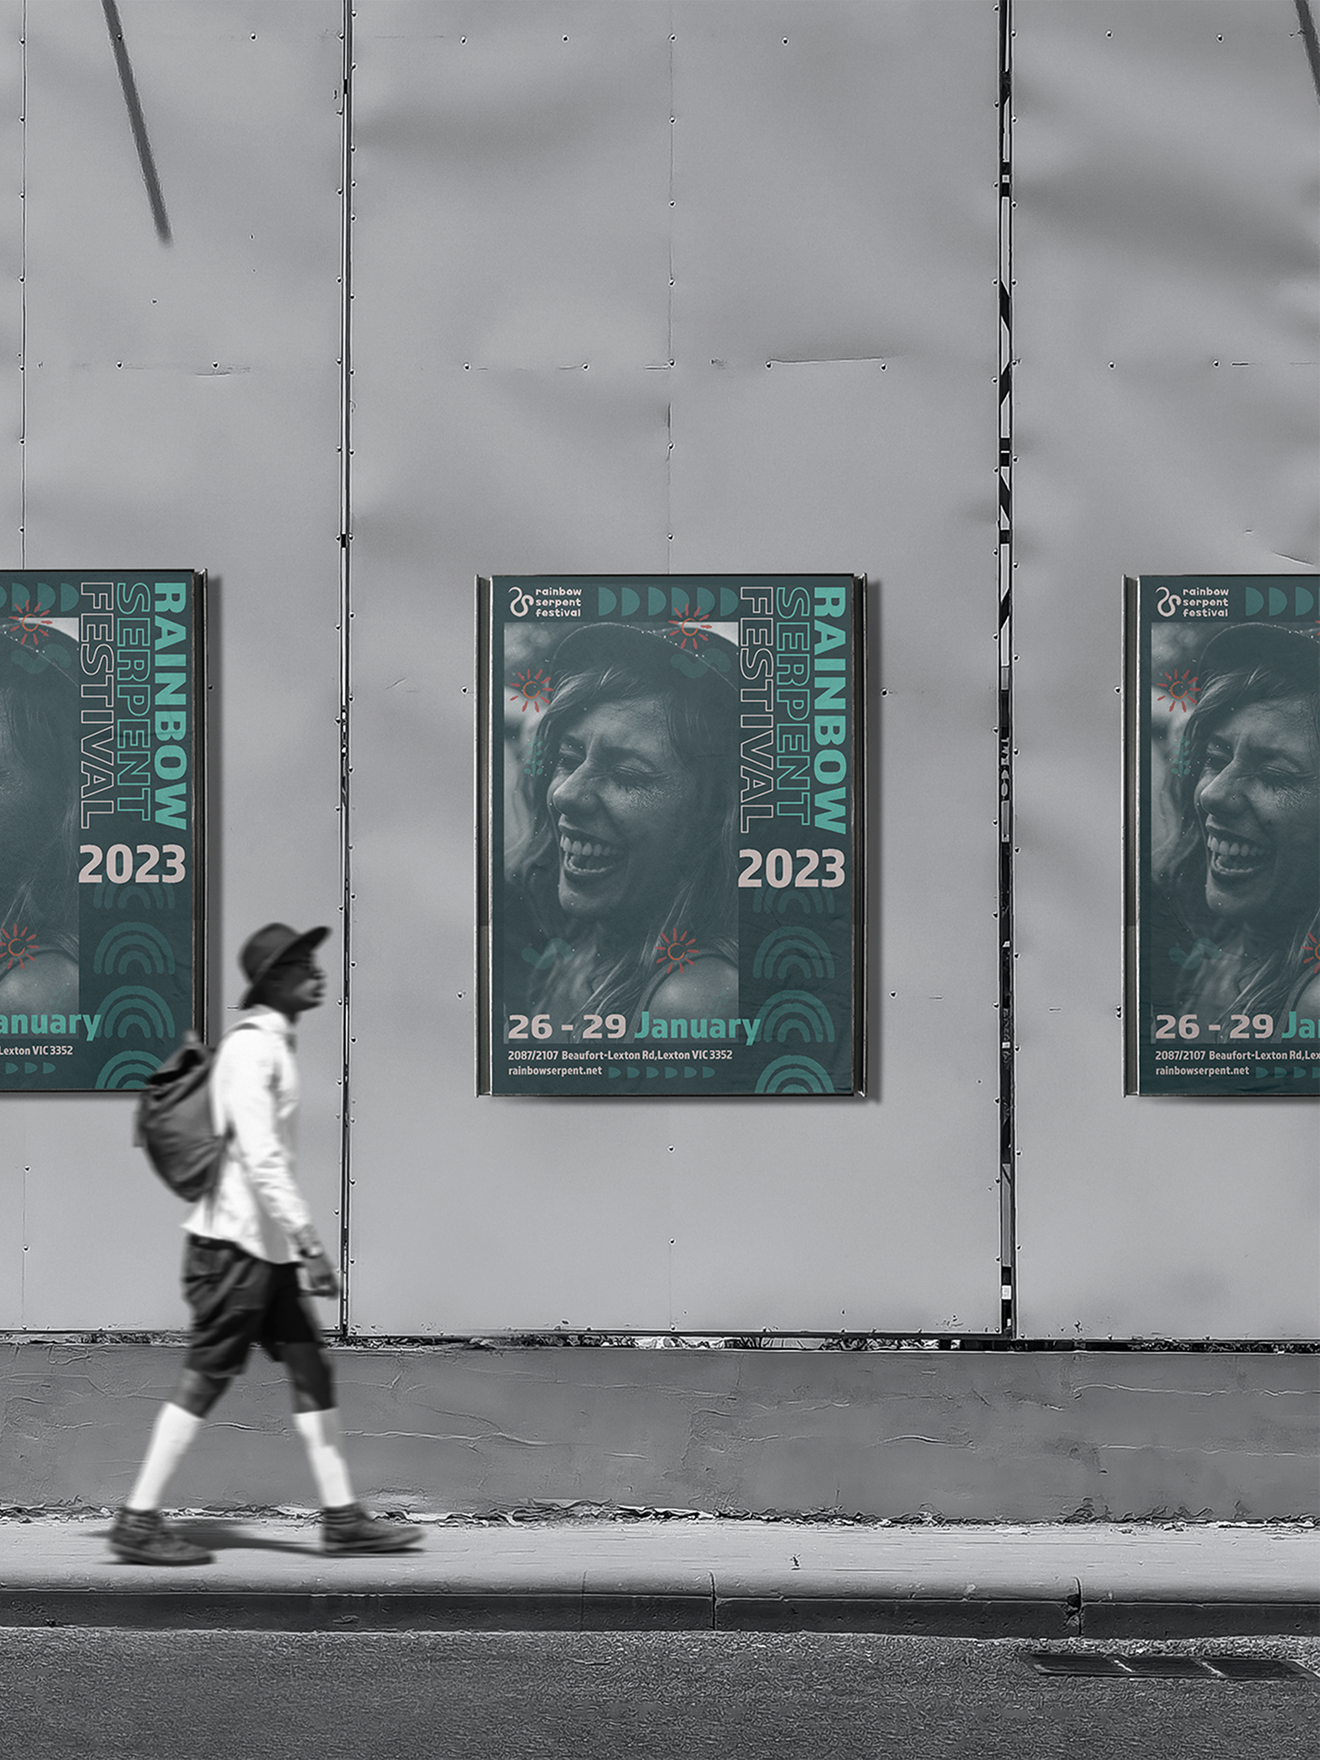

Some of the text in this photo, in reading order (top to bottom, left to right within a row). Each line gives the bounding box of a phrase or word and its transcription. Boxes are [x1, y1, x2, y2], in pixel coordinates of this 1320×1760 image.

[535, 586, 582, 596] rainbow
[1183, 586, 1230, 596] rainbow
[535, 597, 581, 608] serpent
[1183, 597, 1229, 608] serpent
[535, 608, 581, 617] festival
[1183, 608, 1229, 617] festival
[81, 582, 115, 829] FESTIVAL
[117, 582, 151, 821] SERPENT
[154, 582, 187, 830] RAINBOW
[776, 586, 810, 825] SERPENT
[740, 586, 774, 833] FESTIVAL
[813, 586, 846, 834] RAINBOW
[78, 844, 187, 884] 2023
[737, 848, 846, 888] 2023
[507, 1013, 553, 1039] 26
[581, 1013, 627, 1039] 29
[634, 1010, 761, 1046] January
[1155, 1013, 1201, 1039] 26
[1229, 1013, 1275, 1039] 29
[32, 1046, 49, 1056] VIC
[50, 1046, 74, 1056] 3352
[507, 1050, 558, 1060] 2087/2107
[561, 1050, 640, 1060] Beaufort-Lexton
[691, 1050, 708, 1060] VIC
[709, 1050, 733, 1060] 3352
[1155, 1050, 1206, 1060] 2087/2107
[1209, 1050, 1288, 1060] Beaufort-Lexton
[508, 1065, 602, 1078] rainbowserpent.net
[1156, 1065, 1250, 1078] rainbowserpent.net
